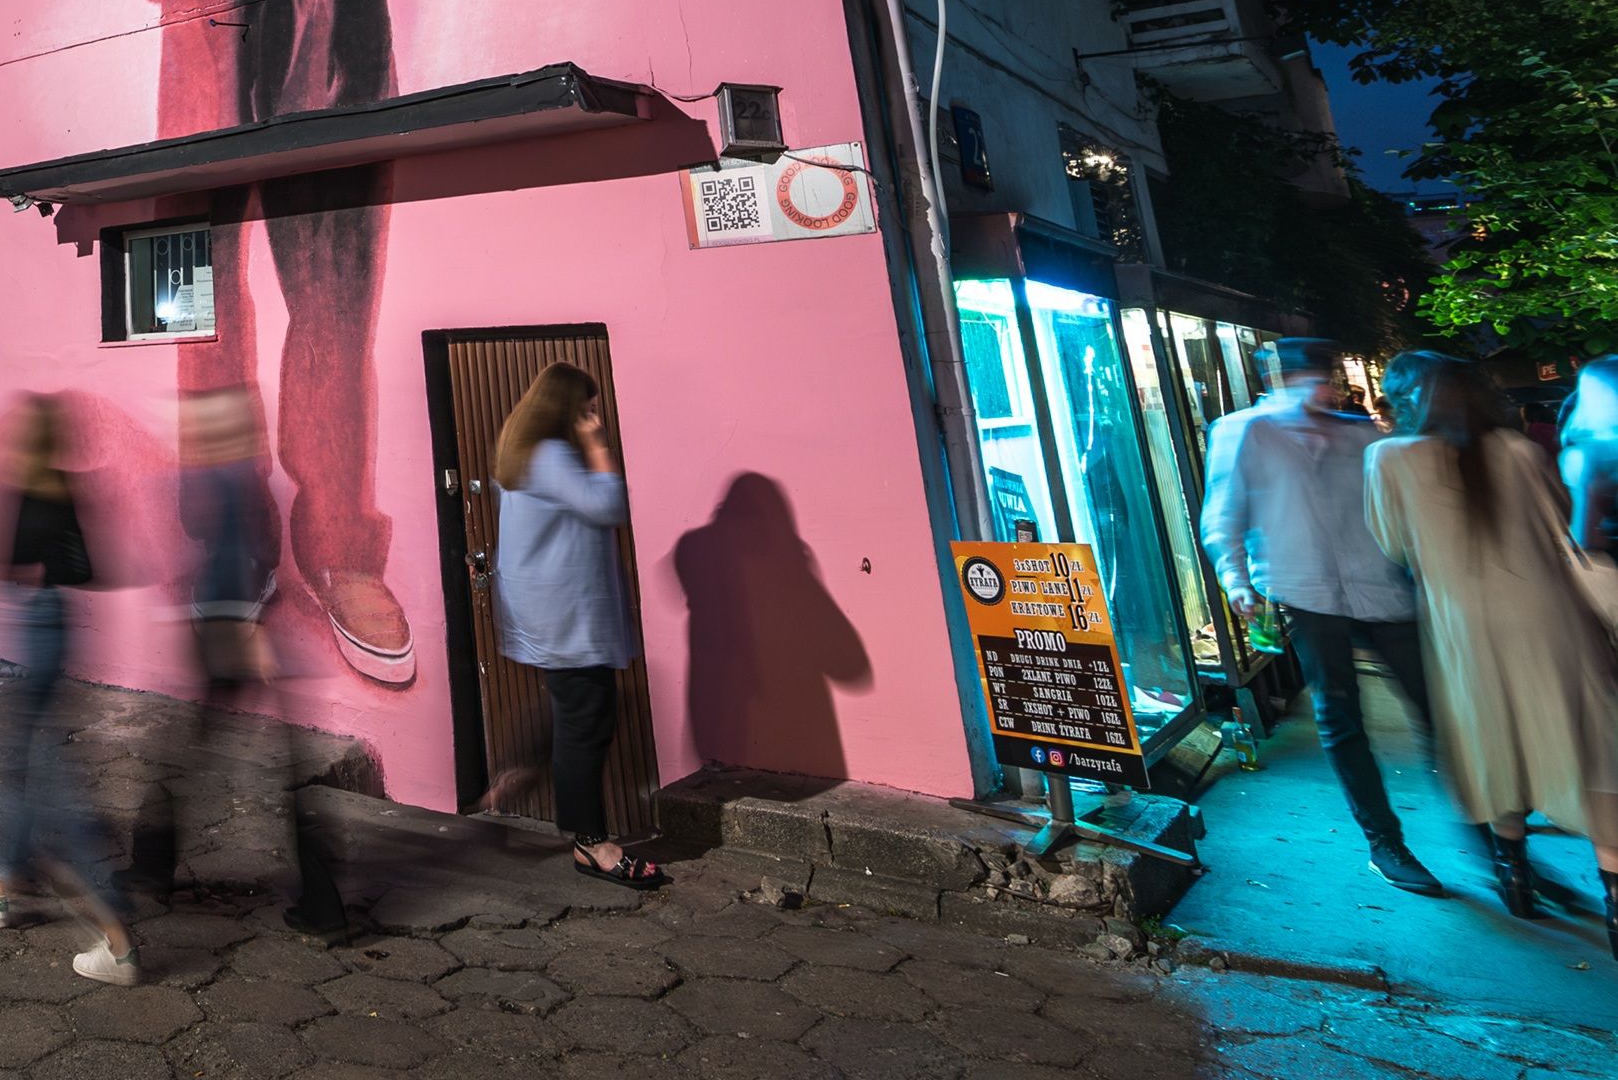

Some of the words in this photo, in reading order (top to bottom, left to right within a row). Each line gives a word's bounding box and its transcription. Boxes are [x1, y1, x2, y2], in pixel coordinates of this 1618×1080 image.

[779, 162, 801, 192] GOOD
[805, 156, 853, 186] OONG
[781, 199, 830, 229] LOOKING
[832, 193, 856, 223] GOOD
[1050, 552, 1070, 577] 10
[1011, 580, 1037, 594] PIWO
[1041, 582, 1068, 595] LANE
[1065, 577, 1085, 603] 11
[1011, 601, 1065, 617] KRAFTOWE
[1067, 604, 1089, 630] 16
[1014, 629, 1066, 652] PROMO
[986, 650, 998, 661] ND
[1010, 653, 1033, 665] DRUGI
[1035, 656, 1060, 667] DRINK
[1062, 658, 1082, 669] DNIA
[988, 665, 1005, 678] PON
[1021, 669, 1053, 683] 2XLANE
[1055, 672, 1077, 686] PIWO
[1093, 677, 1114, 690] 12ZŁ
[992, 682, 1006, 694] WT
[1033, 687, 1073, 702] SANGRIA
[1095, 694, 1118, 708] 10ZŁ
[1023, 701, 1054, 716] 3XSHOT
[1057, 708, 1065, 717] +
[1068, 707, 1091, 721] PIWO
[1101, 711, 1121, 725] 16ZŁ
[999, 716, 1015, 729] CZW
[1031, 720, 1058, 735] DRINK
[1058, 723, 1092, 740] ŻYRAFA
[1105, 731, 1126, 745] 16ZŁ
[1069, 753, 1122, 773] /barzyrafa
